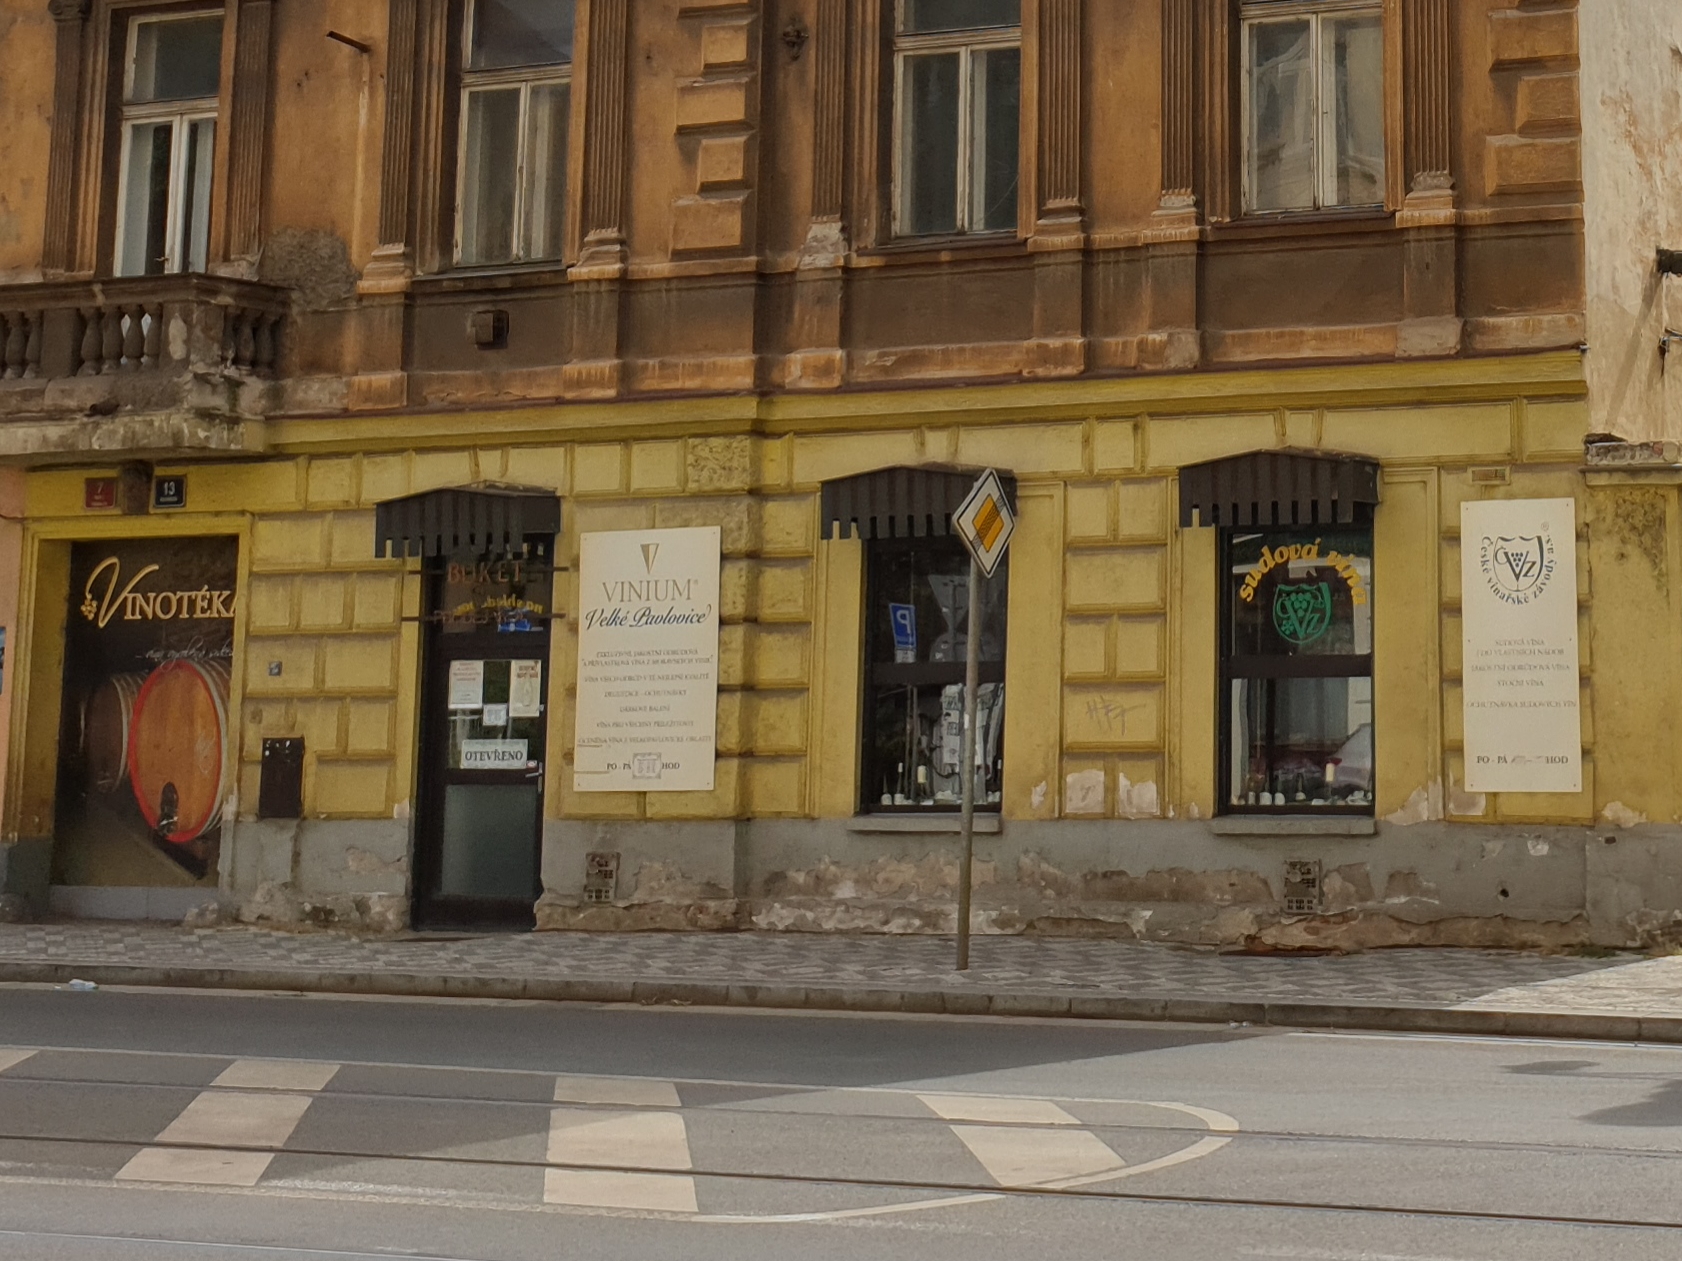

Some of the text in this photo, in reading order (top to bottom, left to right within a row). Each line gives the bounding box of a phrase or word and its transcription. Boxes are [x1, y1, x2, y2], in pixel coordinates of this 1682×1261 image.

[163, 481, 176, 495] 13
[1239, 537, 1367, 605] sudová vína
[602, 579, 692, 603] VINIUM
[585, 604, 712, 630] Velké Pavlovice
[465, 749, 524, 762] OTEVŘENO
[1476, 755, 1490, 764] PO
[1497, 754, 1508, 764] PÁ
[1545, 755, 1569, 764] HOD
[606, 762, 617, 770] PO
[661, 762, 680, 770] HOD
